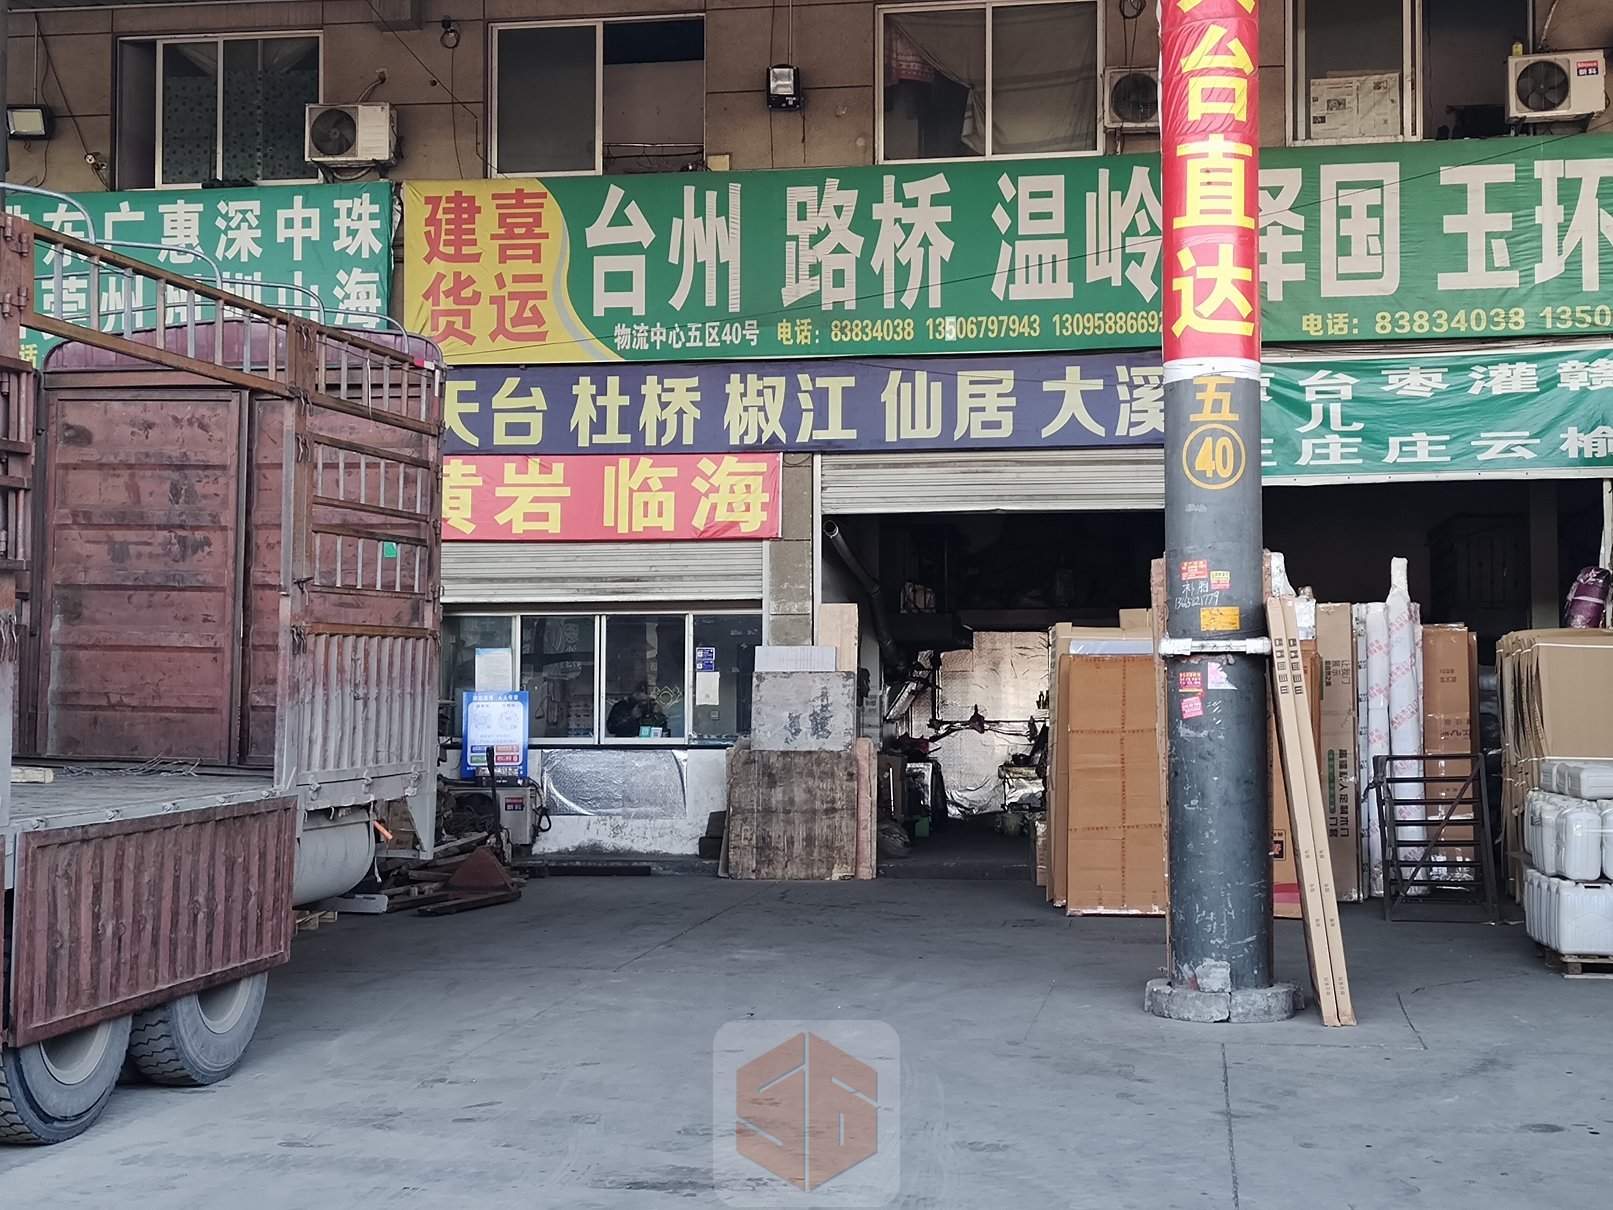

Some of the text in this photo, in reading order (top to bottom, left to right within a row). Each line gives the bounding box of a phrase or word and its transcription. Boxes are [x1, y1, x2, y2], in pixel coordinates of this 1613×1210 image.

[1173, 0, 1255, 337] 台直达
[423, 188, 550, 265] 建喜
[585, 182, 742, 317] 台州
[780, 172, 955, 311] 路桥
[991, 165, 1163, 304] 温岭
[1438, 158, 1613, 292] 玉环
[422, 270, 549, 346] 货运
[613, 319, 760, 350] 物流中心五区40号
[831, 319, 915, 342] 83834038
[926, 314, 1041, 341] 13506797943
[1374, 307, 1526, 334] 83834038
[569, 375, 702, 448] 杜桥
[724, 372, 858, 446] 椒江
[881, 369, 1017, 442] 仙居
[1041, 365, 1164, 439] 大溪
[1189, 375, 1239, 421] 五
[603, 456, 770, 534] 临海
[1194, 435, 1235, 479] 40
